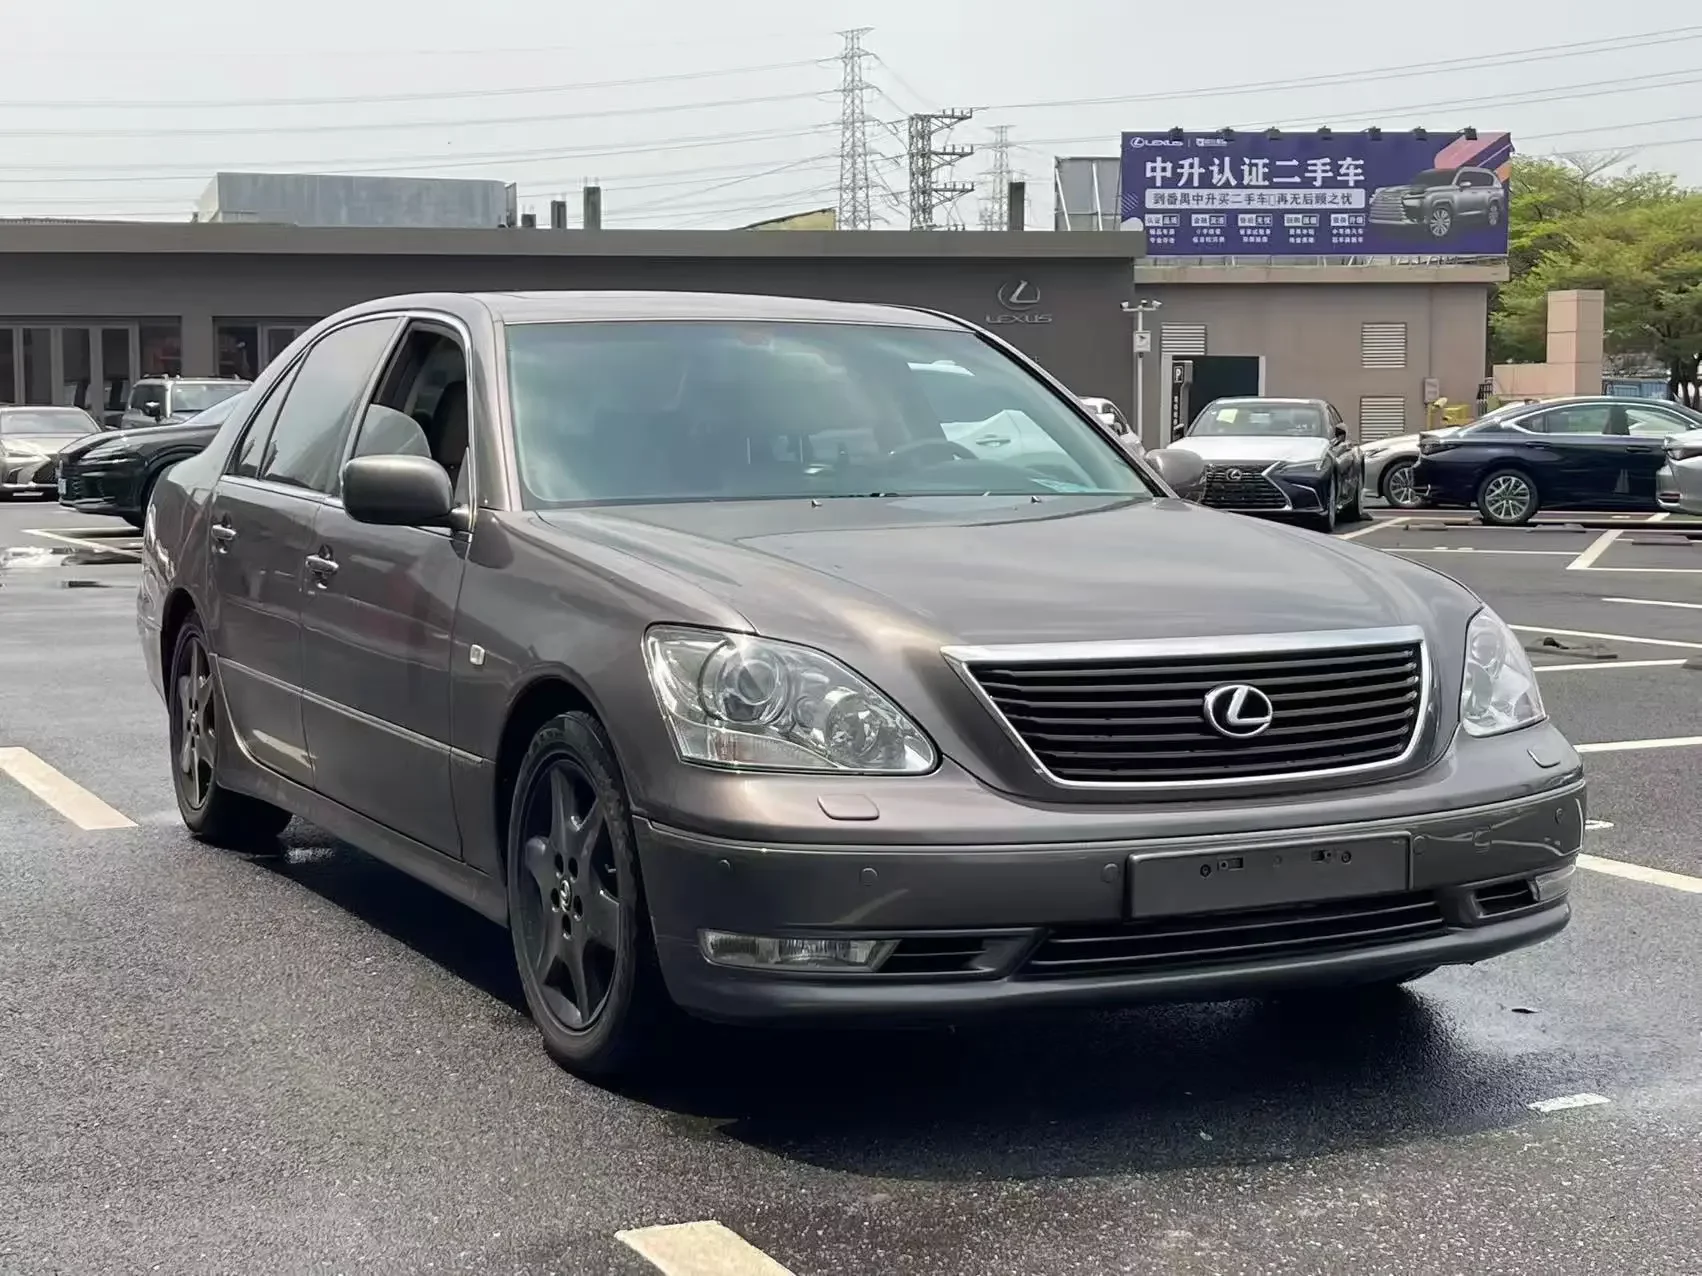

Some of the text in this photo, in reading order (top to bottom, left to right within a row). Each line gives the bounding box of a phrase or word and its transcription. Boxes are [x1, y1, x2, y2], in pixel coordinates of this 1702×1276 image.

[1145, 139, 1184, 147] LEXUS
[1145, 156, 1365, 187] 中升认证二手车
[985, 313, 1053, 324] LEXUS
